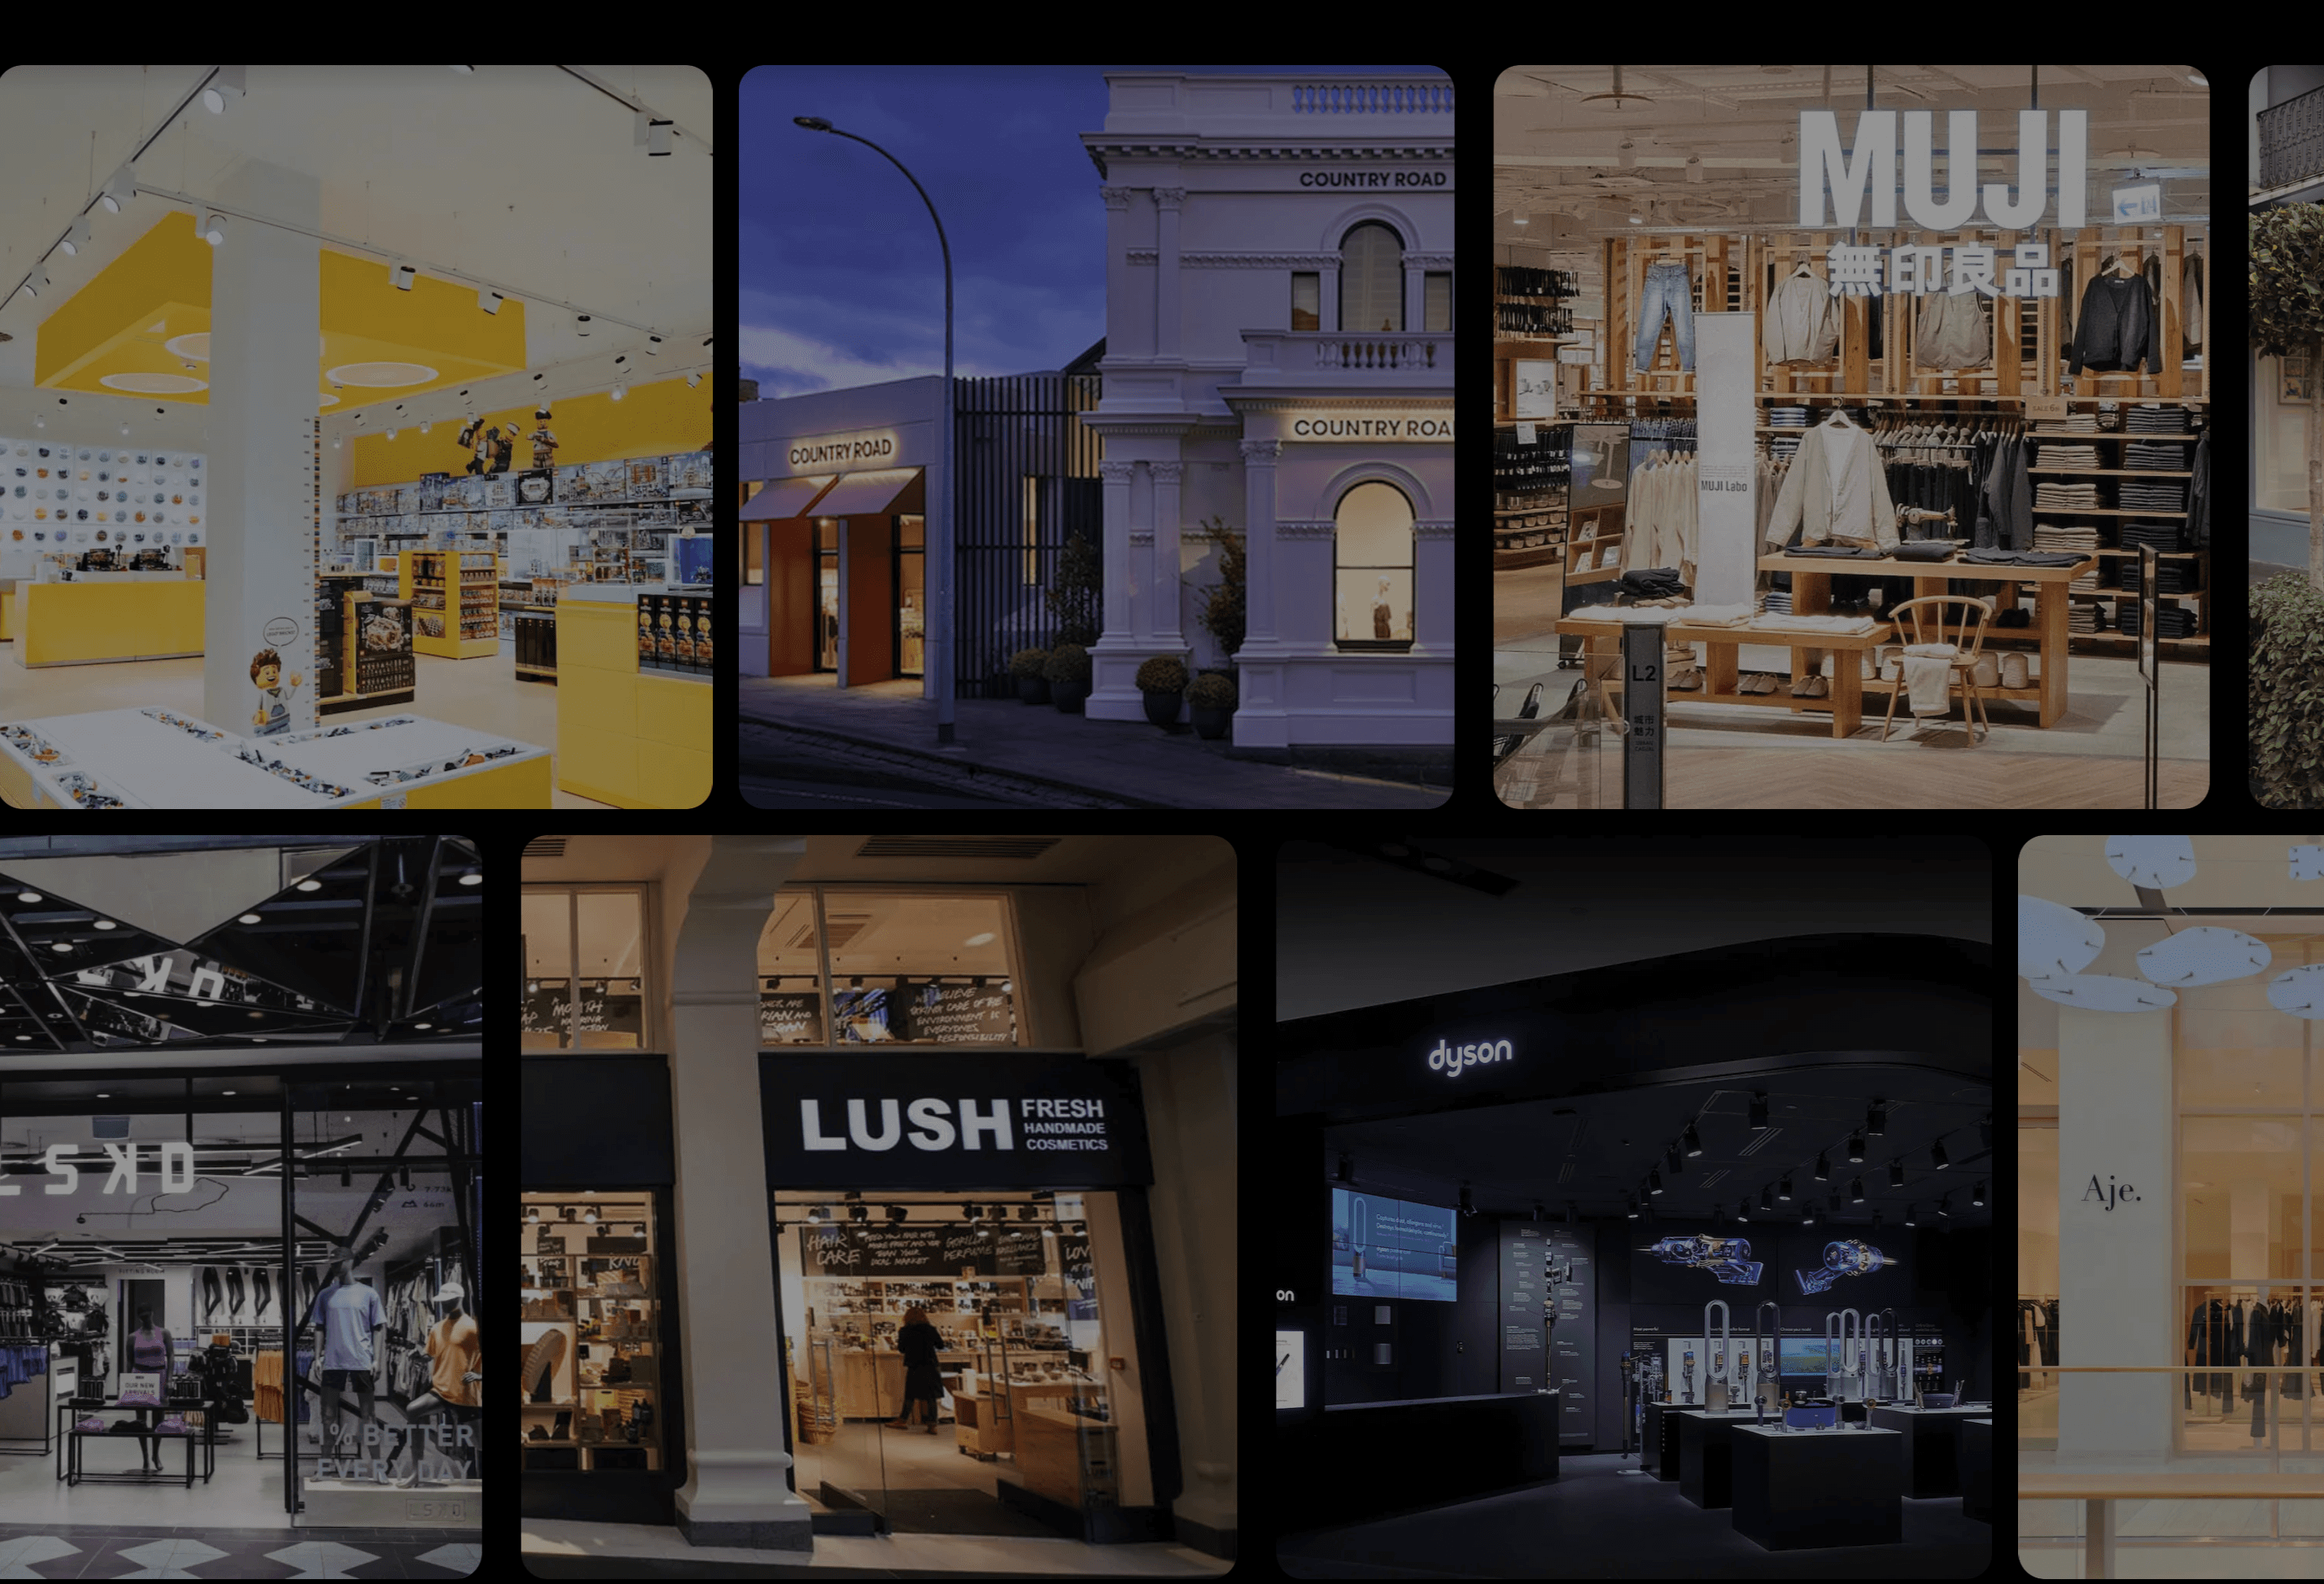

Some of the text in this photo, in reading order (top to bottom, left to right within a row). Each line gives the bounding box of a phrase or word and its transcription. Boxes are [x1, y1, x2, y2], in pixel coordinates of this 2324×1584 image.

[1799, 109, 2087, 230] MUJI
[1300, 172, 1447, 187] COUNTRY ROAD
[1827, 241, 2059, 298] 無印良品
[1295, 419, 1455, 436] COUNTRY ROA
[790, 438, 892, 464] COUNTRY ROAD
[1701, 480, 1748, 492] MUJI Labo
[1632, 664, 1657, 682] L2
[1634, 715, 1654, 724] 城市
[916, 1011, 986, 1026] ENVIRONMENT
[1428, 1039, 1513, 1078] dyson
[800, 1097, 1105, 1153] LUSH FRESH
[1024, 1122, 1106, 1135] HANDMADE
[1026, 1138, 1109, 1151] COSMETICS
[2081, 1174, 2142, 1211] Aje.
[806, 1232, 848, 1251] HAIR
[946, 1234, 986, 1248] GORILLA
[816, 1248, 861, 1266] CARE
[893, 1256, 931, 1266] MARKET
[943, 1245, 993, 1262] PERFUME
[363, 1424, 475, 1447] BETTER
[317, 1458, 473, 1482] EVERY DAY
